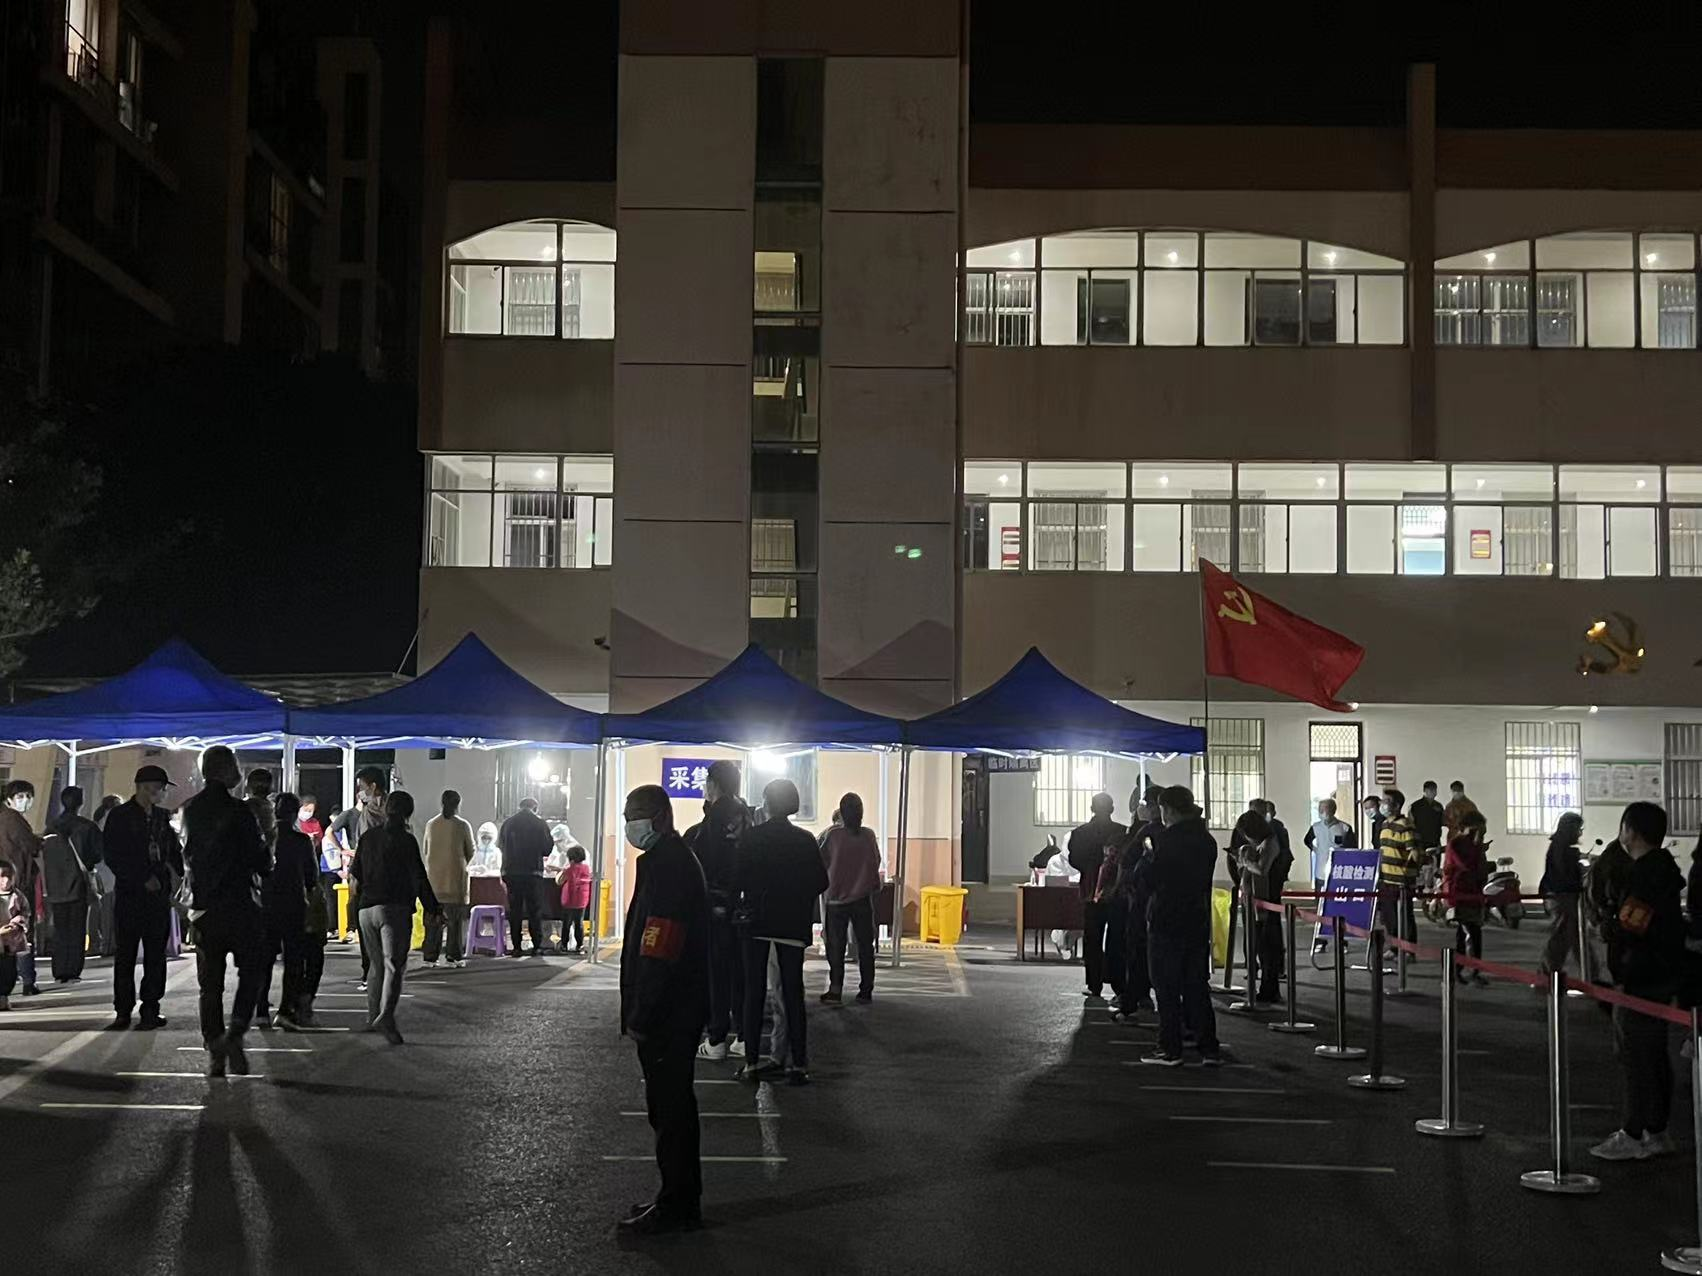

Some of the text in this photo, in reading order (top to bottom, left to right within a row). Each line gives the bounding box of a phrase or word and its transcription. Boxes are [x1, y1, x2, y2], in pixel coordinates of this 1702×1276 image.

[669, 766, 709, 790] 采集
[1332, 864, 1375, 880] 核酸检测
